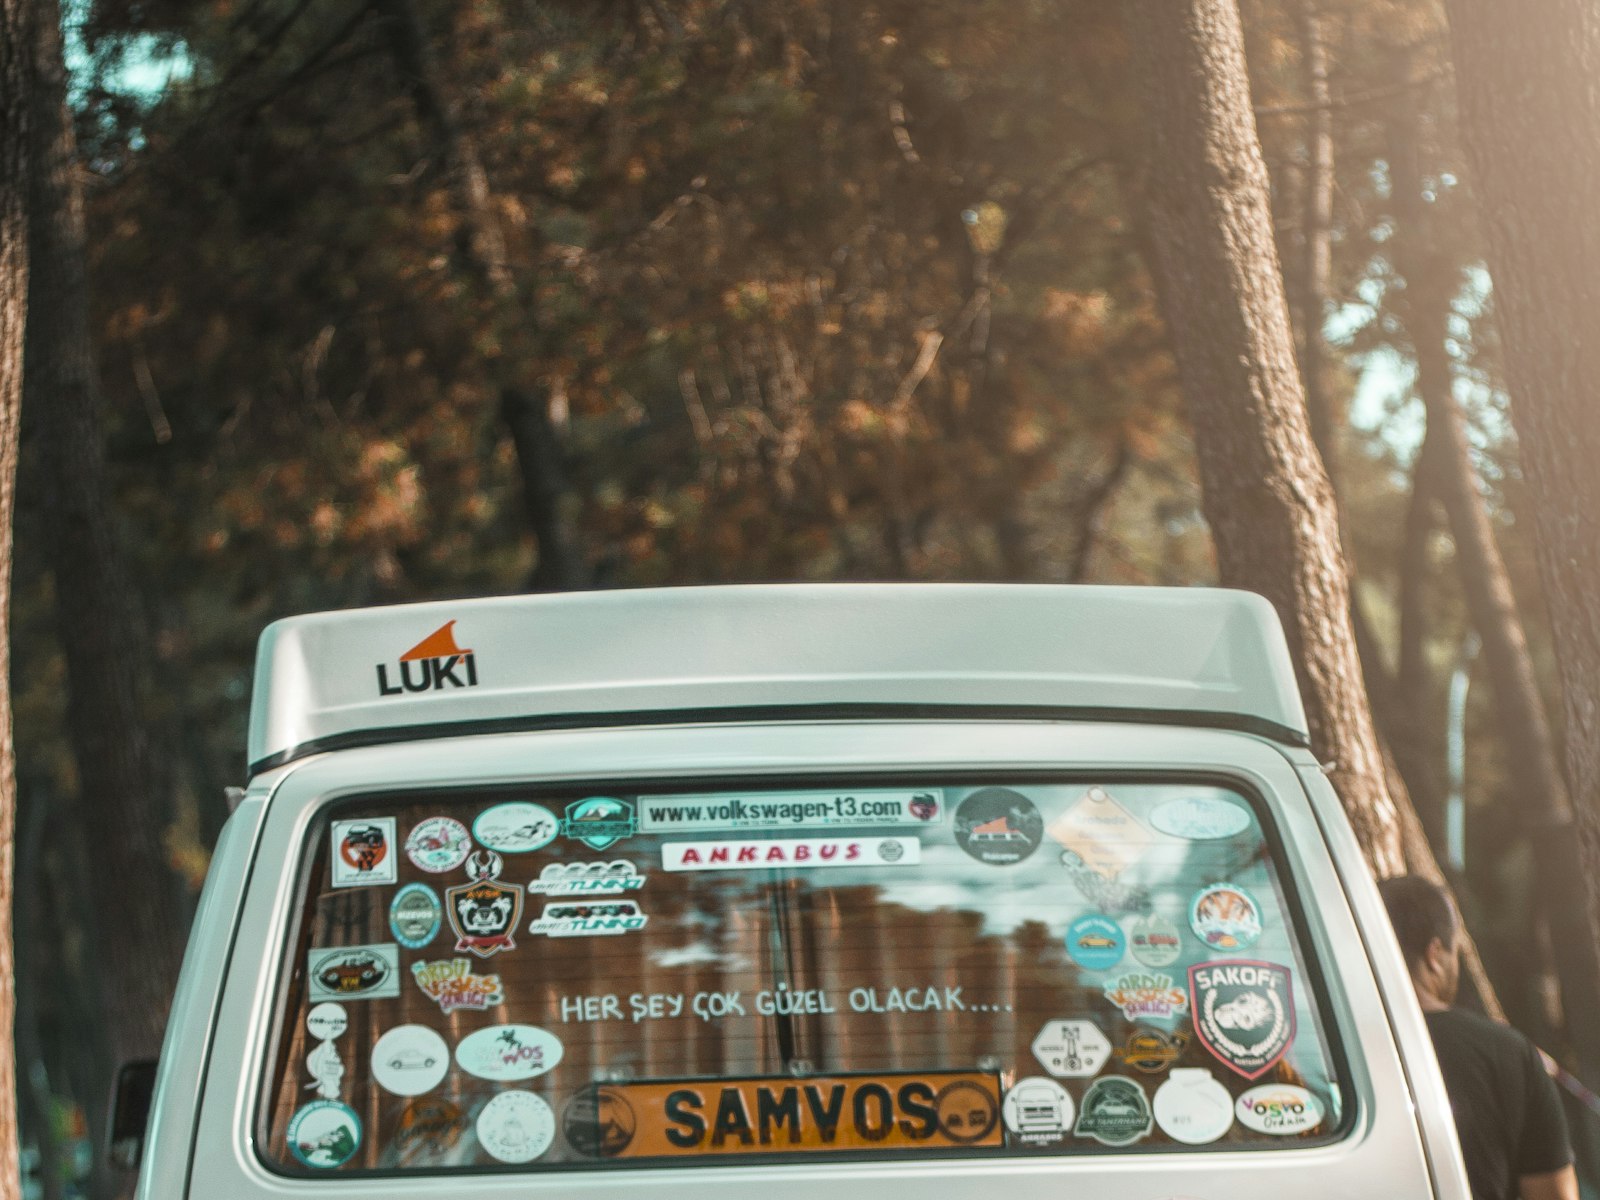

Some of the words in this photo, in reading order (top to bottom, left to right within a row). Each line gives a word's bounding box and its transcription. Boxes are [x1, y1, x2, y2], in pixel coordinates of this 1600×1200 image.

[376, 653, 477, 696] LUKI
[649, 797, 902, 823] www.volkswagen-t3.com
[681, 843, 862, 864] ANKABUS
[561, 994, 625, 1023] HER
[629, 992, 684, 1023] ŞEY
[692, 990, 745, 1022] ÇOK
[755, 982, 835, 1016] GÜZEL
[664, 1081, 939, 1148] SAMVOS
